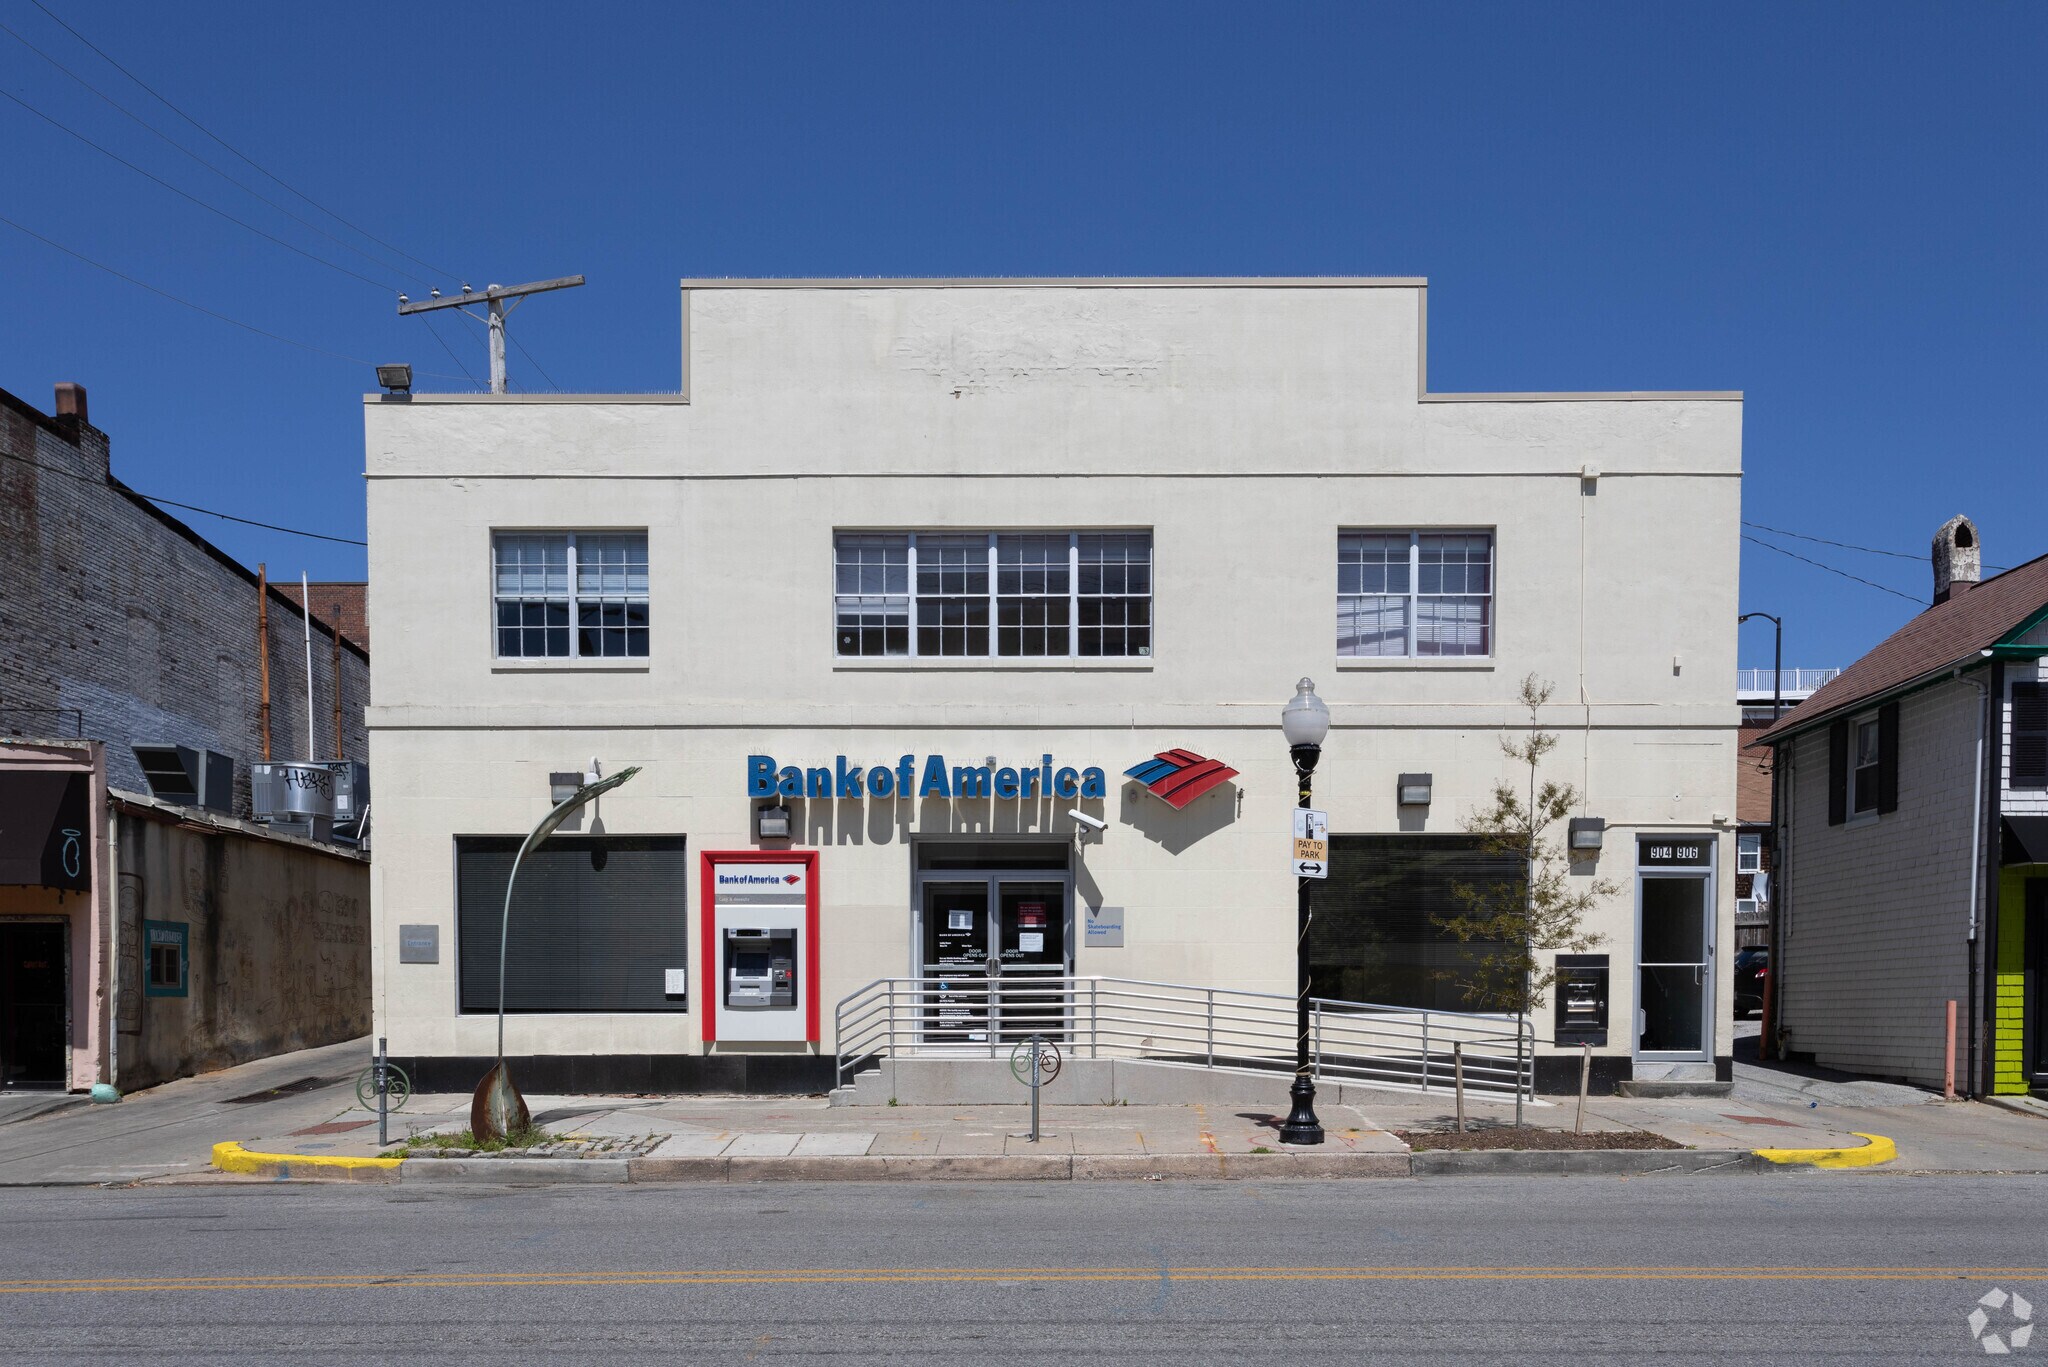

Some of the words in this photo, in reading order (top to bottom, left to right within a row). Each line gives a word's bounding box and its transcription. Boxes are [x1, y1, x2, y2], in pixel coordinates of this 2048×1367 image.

[748, 754, 865, 799] Bank
[867, 753, 915, 799] of
[919, 753, 1106, 800] America
[1298, 840, 1313, 848] PAY
[1300, 850, 1320, 859] PARK
[1651, 847, 1672, 858] 904
[1677, 847, 1698, 858] 906
[719, 875, 740, 884] Bank
[740, 875, 748, 884] of
[748, 875, 779, 884] America
